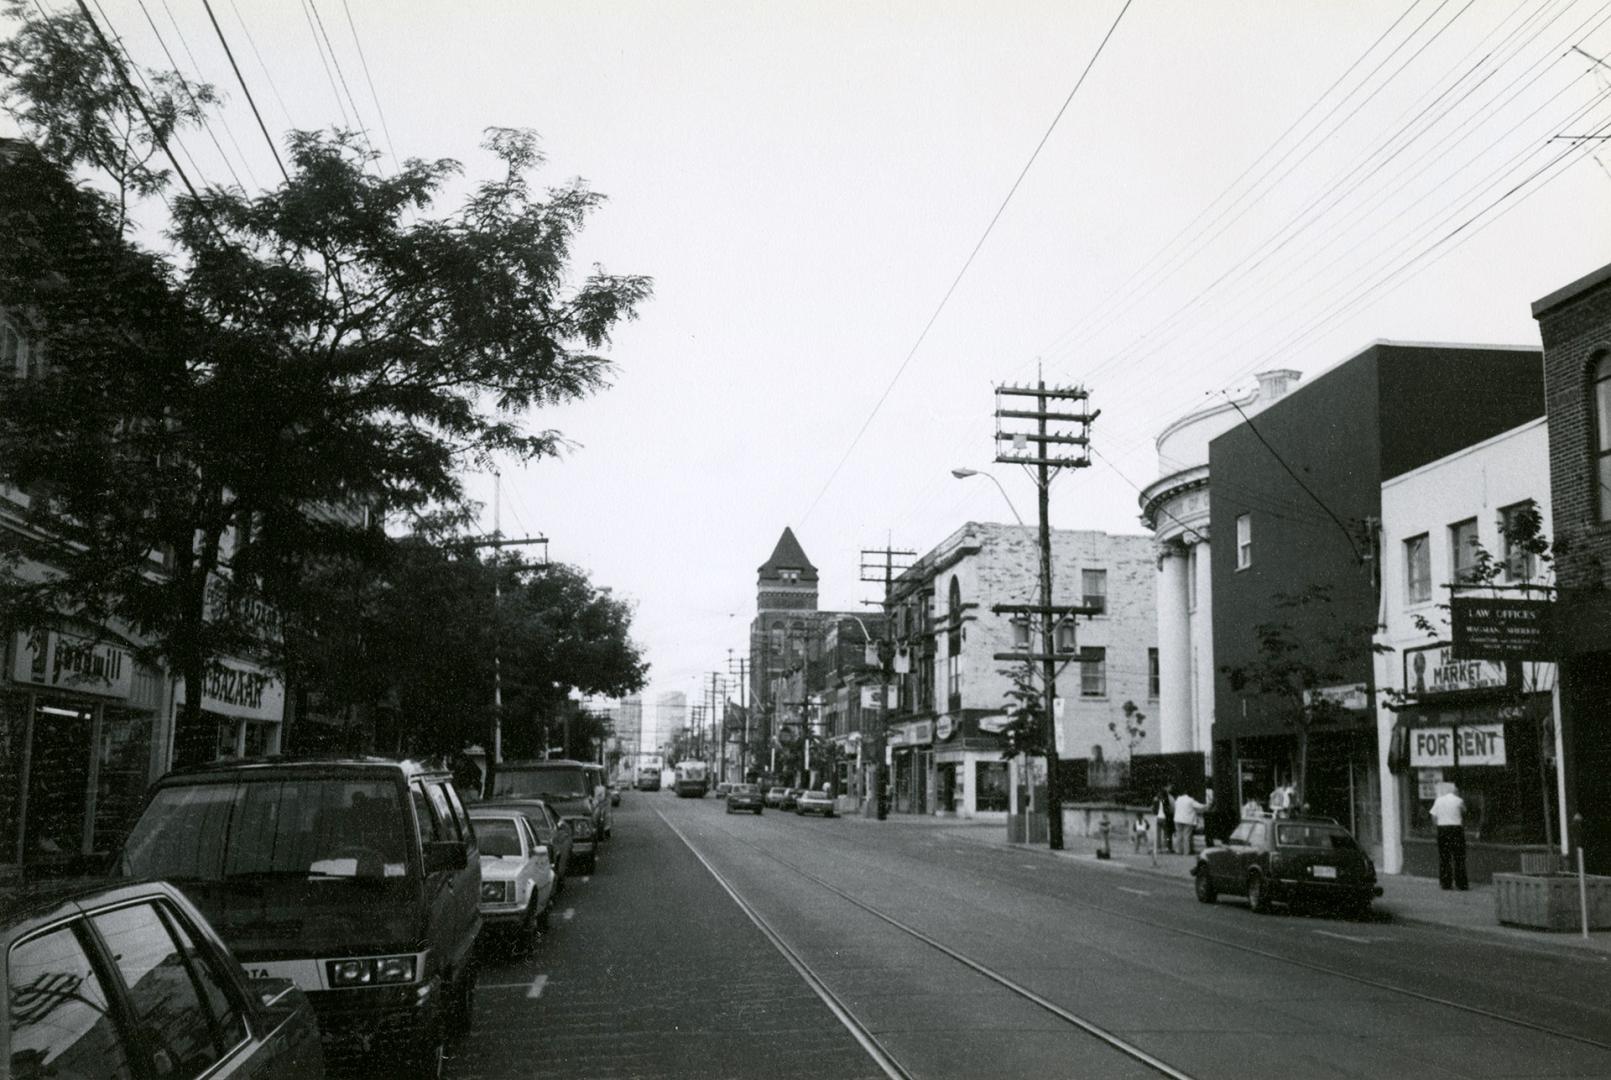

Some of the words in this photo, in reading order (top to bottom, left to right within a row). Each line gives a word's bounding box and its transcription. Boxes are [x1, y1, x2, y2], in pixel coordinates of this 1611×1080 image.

[1468, 608, 1490, 618] LAW
[1495, 609, 1536, 619] OFFICES
[1433, 661, 1482, 685] MARKET
[1417, 733, 1448, 756] FOR
[1457, 731, 1497, 756] RENT
